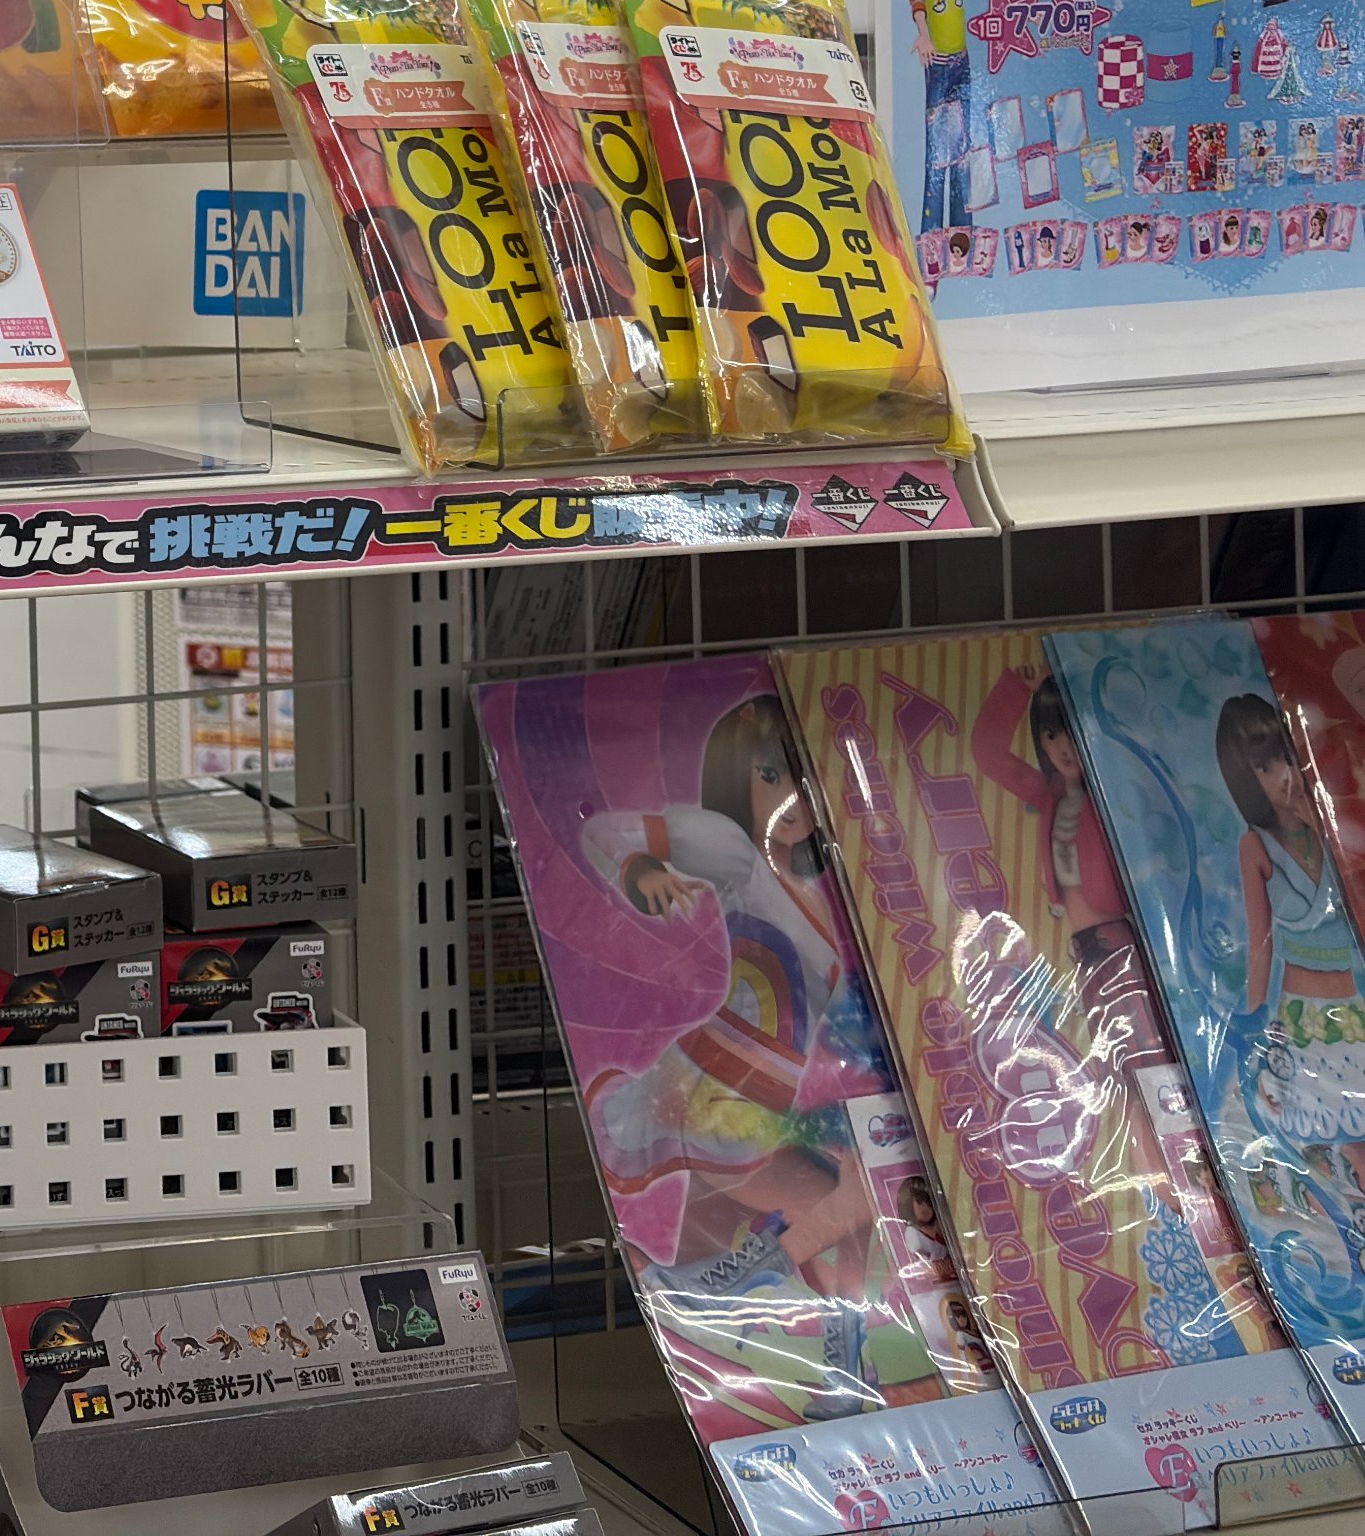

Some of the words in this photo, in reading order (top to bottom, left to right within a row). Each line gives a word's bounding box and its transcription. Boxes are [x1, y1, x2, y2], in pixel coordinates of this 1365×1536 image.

[977, 17, 1003, 39] 1回
[754, 72, 818, 90] ハンドタオル
[395, 86, 457, 100] ハンドタオル
[204, 207, 297, 254] BAN
[203, 253, 283, 298] DAI
[812, 484, 871, 502] 一番くじ
[883, 482, 940, 501] 一番くじ
[256, 869, 313, 887] スタンプ&
[257, 888, 315, 906] ステッカー
[72, 909, 124, 931] スタンプ&
[72, 927, 125, 949] ステッカー
[442, 1268, 475, 1282] FuRyu
[298, 1366, 342, 1387] 全10種
[114, 1375, 295, 1413] つながる蓄光ラバー
[71, 1390, 111, 1420] F賞
[1051, 1399, 1102, 1418] SEGA
[1136, 1423, 1154, 1433] セガ
[1154, 1415, 1199, 1431] ラッキーくじ
[1142, 1428, 1189, 1446] オシャレ魔女
[1189, 1426, 1206, 1440] ラブ
[1207, 1422, 1224, 1435] and
[1225, 1420, 1246, 1432] ベリー
[524, 1479, 558, 1497] 全10種
[403, 1484, 521, 1520] つながる蓄光ラバー
